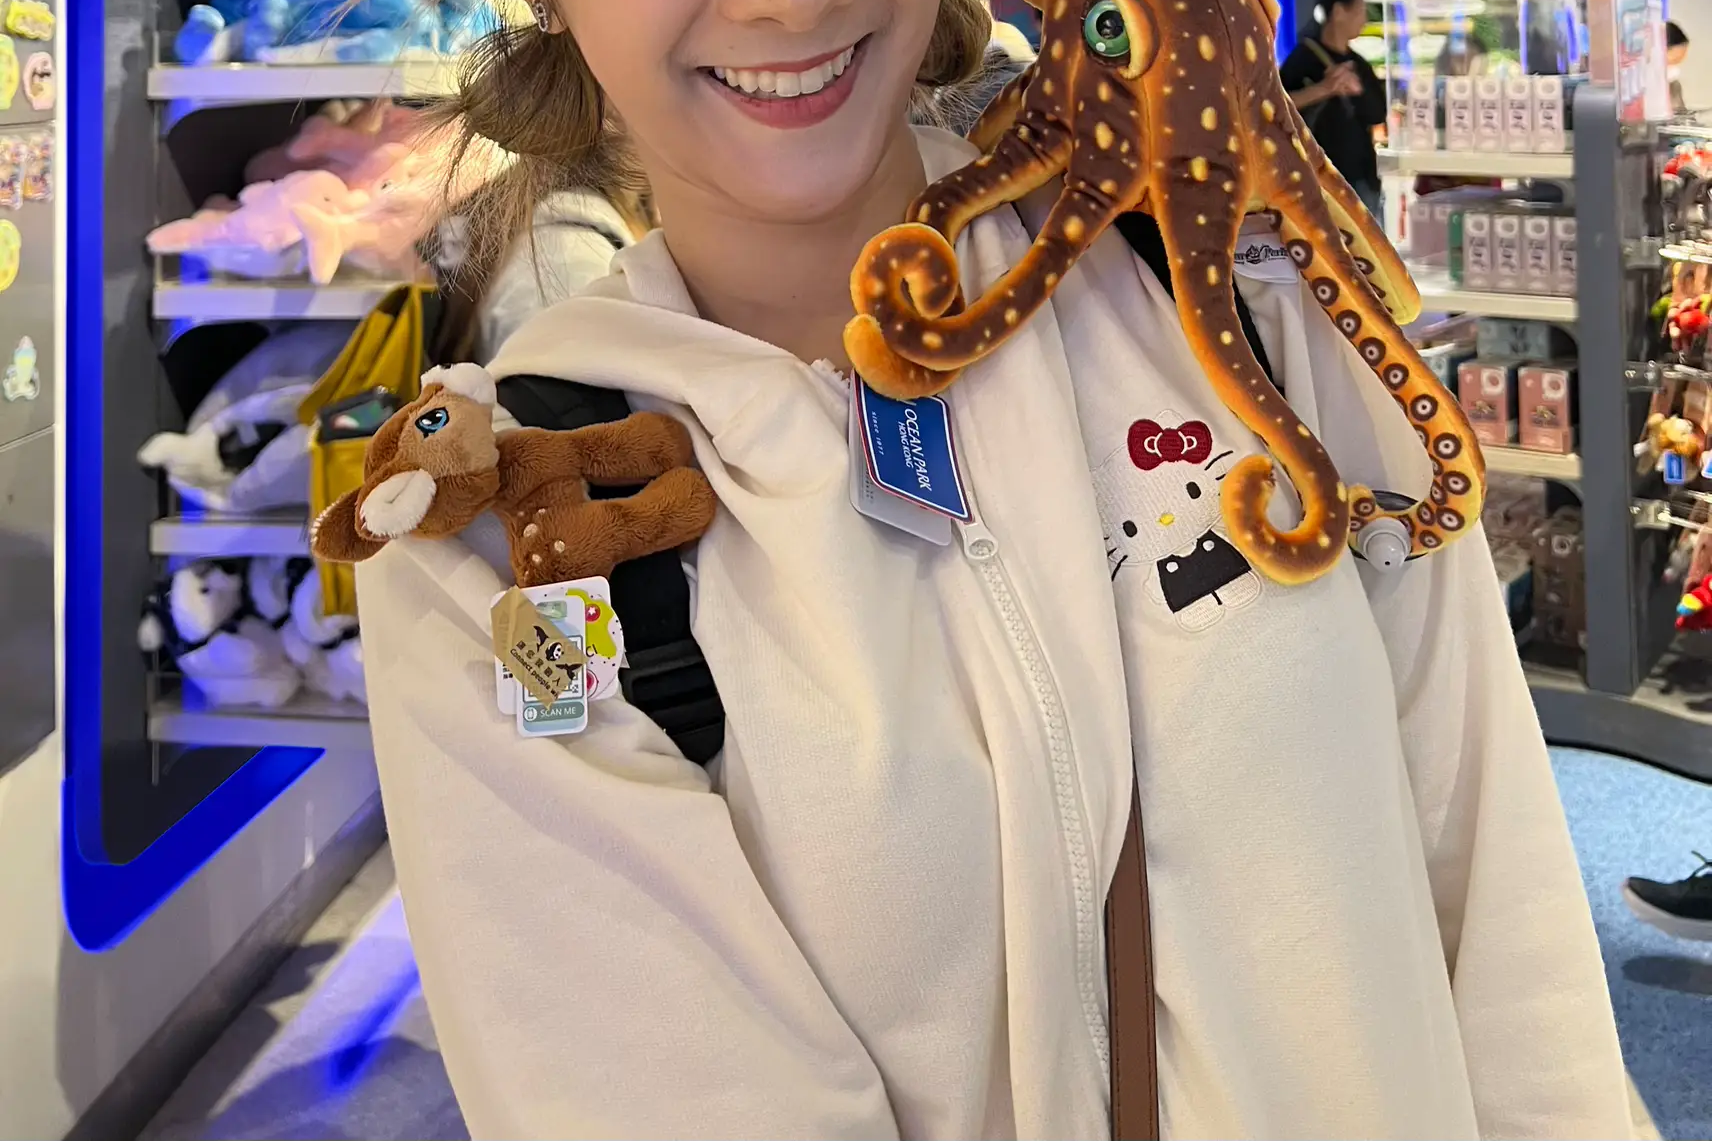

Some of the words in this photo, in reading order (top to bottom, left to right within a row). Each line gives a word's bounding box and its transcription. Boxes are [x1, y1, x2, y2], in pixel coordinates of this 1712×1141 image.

[898, 420, 909, 445] HONG
[904, 408, 924, 457] OCEAN
[903, 444, 914, 469] KONG
[913, 456, 932, 491] PARK
[510, 648, 532, 671] Connect
[531, 670, 550, 690] people
[540, 708, 562, 717] SCAN
[564, 707, 576, 715] ME
